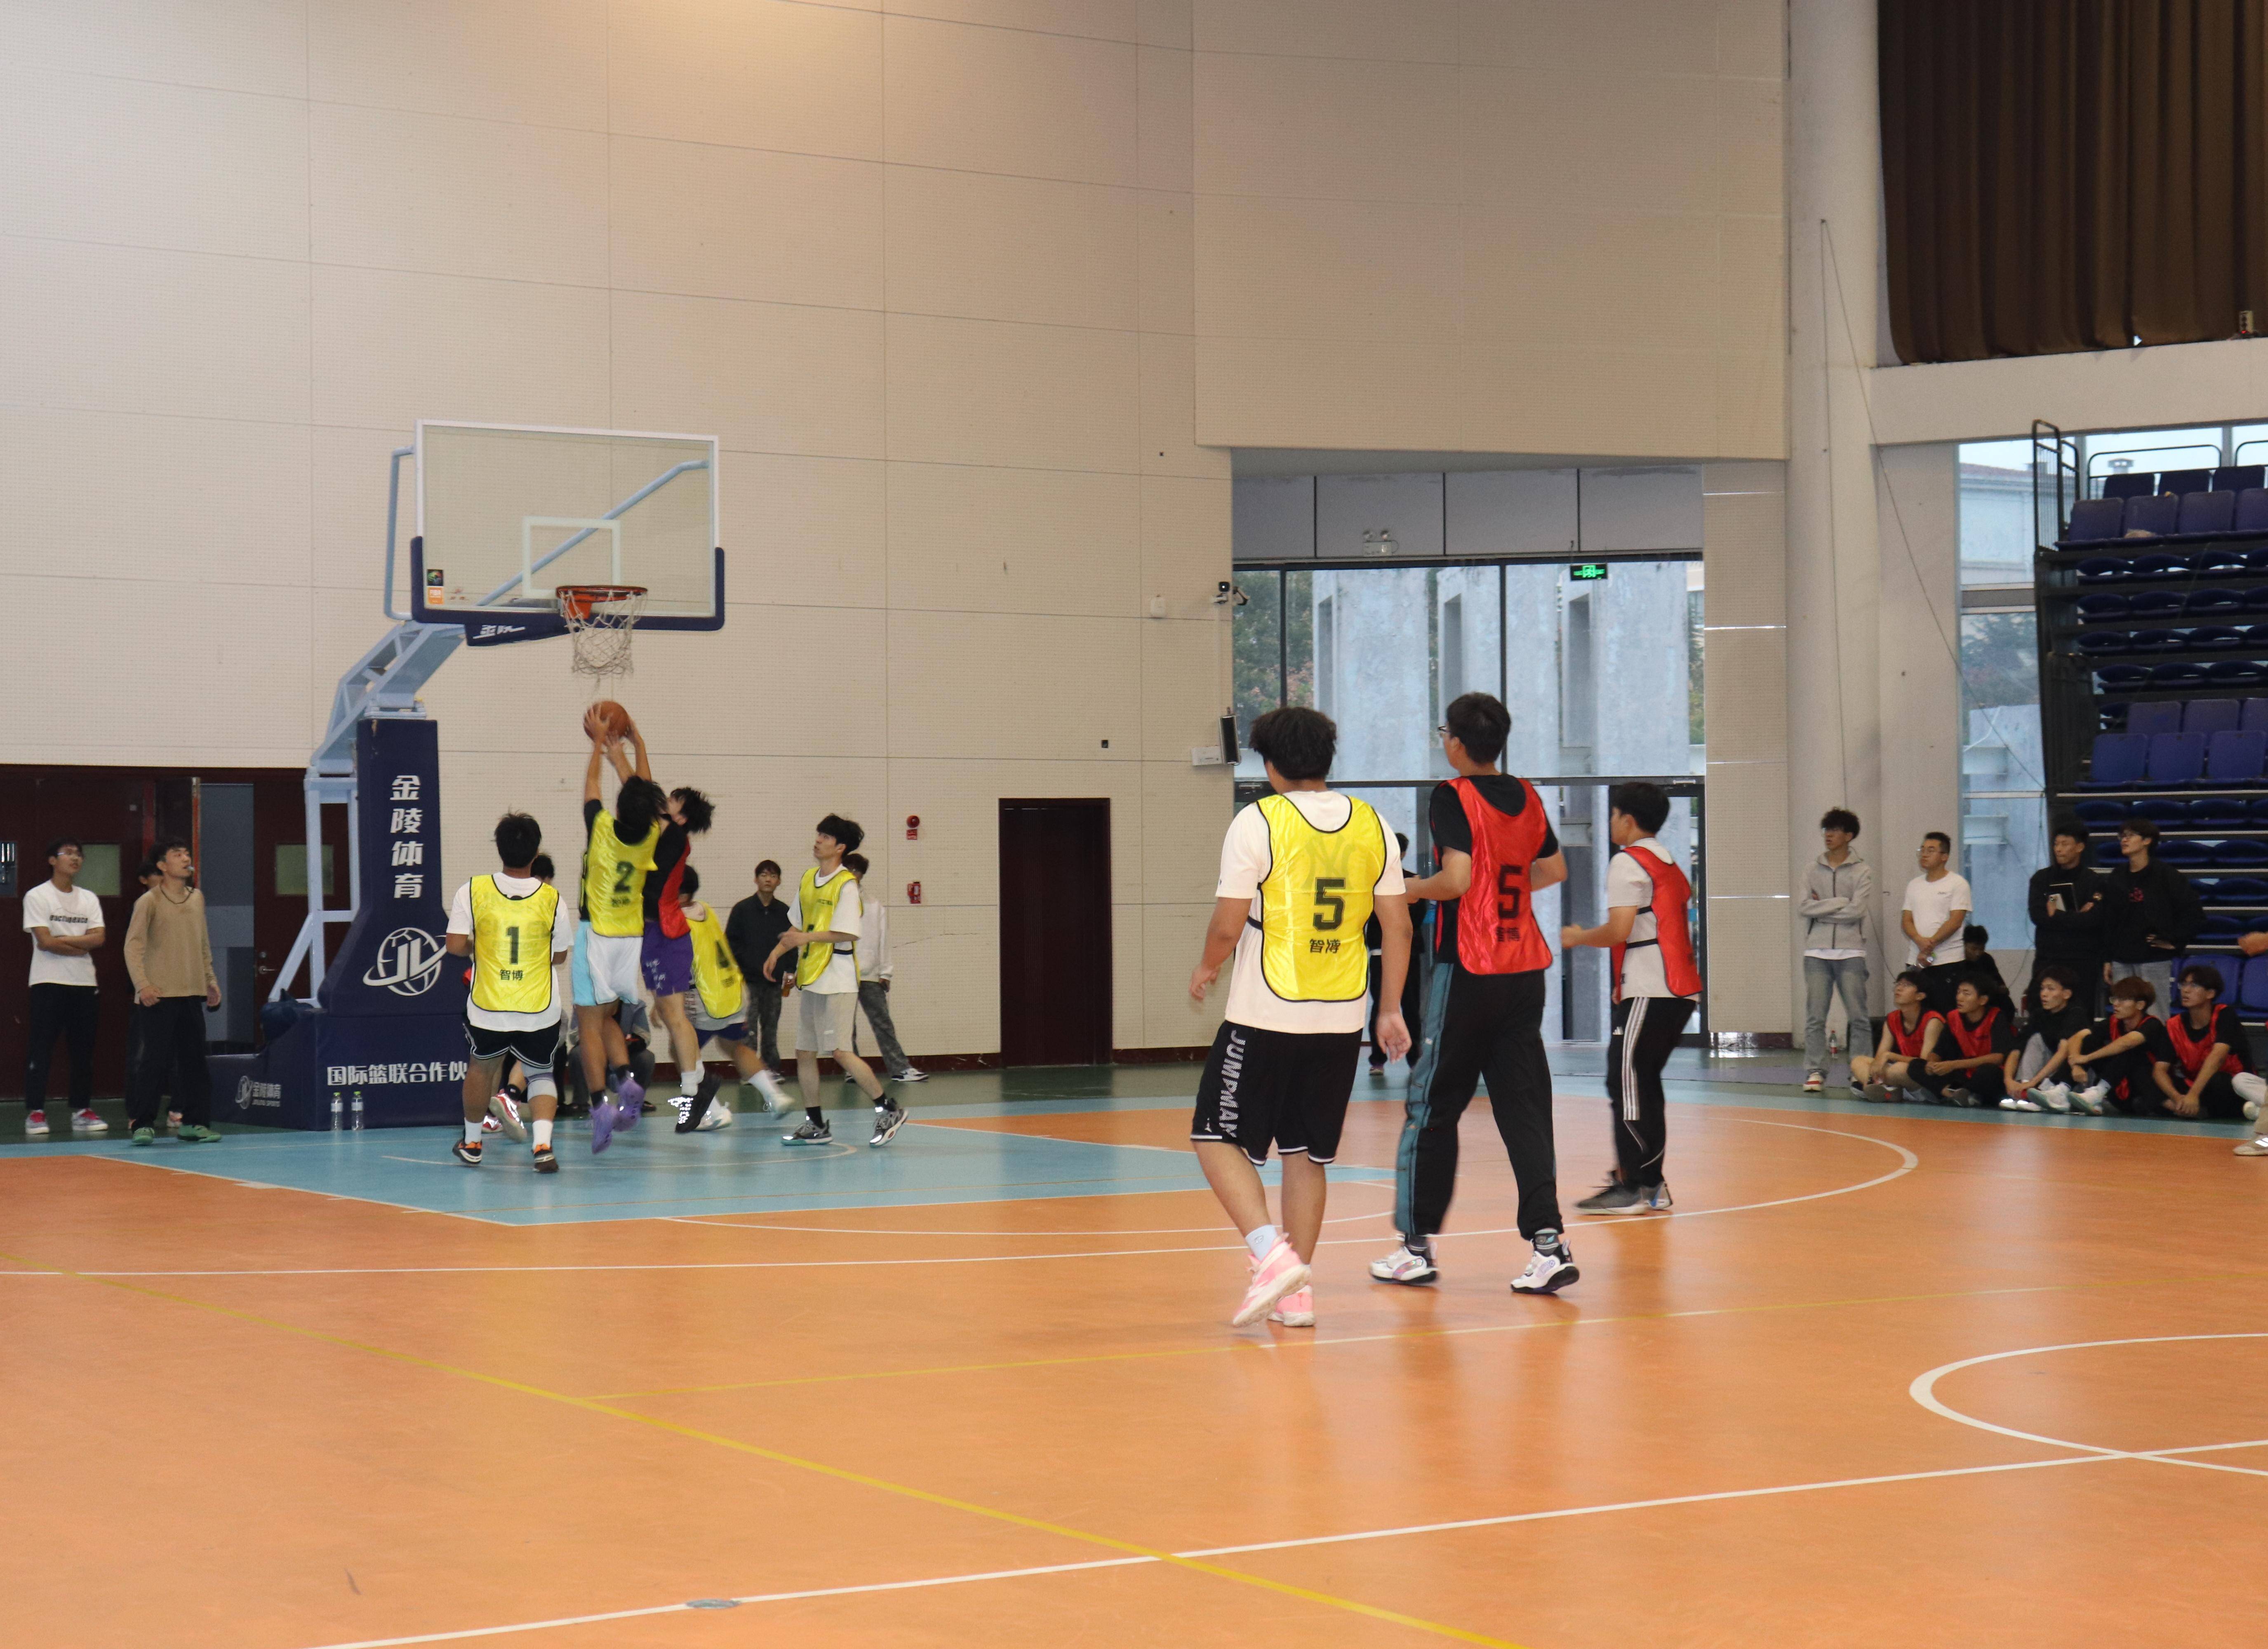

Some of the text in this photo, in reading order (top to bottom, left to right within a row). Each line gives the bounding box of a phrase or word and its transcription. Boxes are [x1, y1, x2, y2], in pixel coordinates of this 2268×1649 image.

[390, 775, 424, 898] 金陵体育
[614, 861, 635, 893] 2
[1498, 864, 1522, 919] 5
[1313, 877, 1346, 931] 5
[506, 926, 519, 965] 1
[499, 970, 524, 981] 智博
